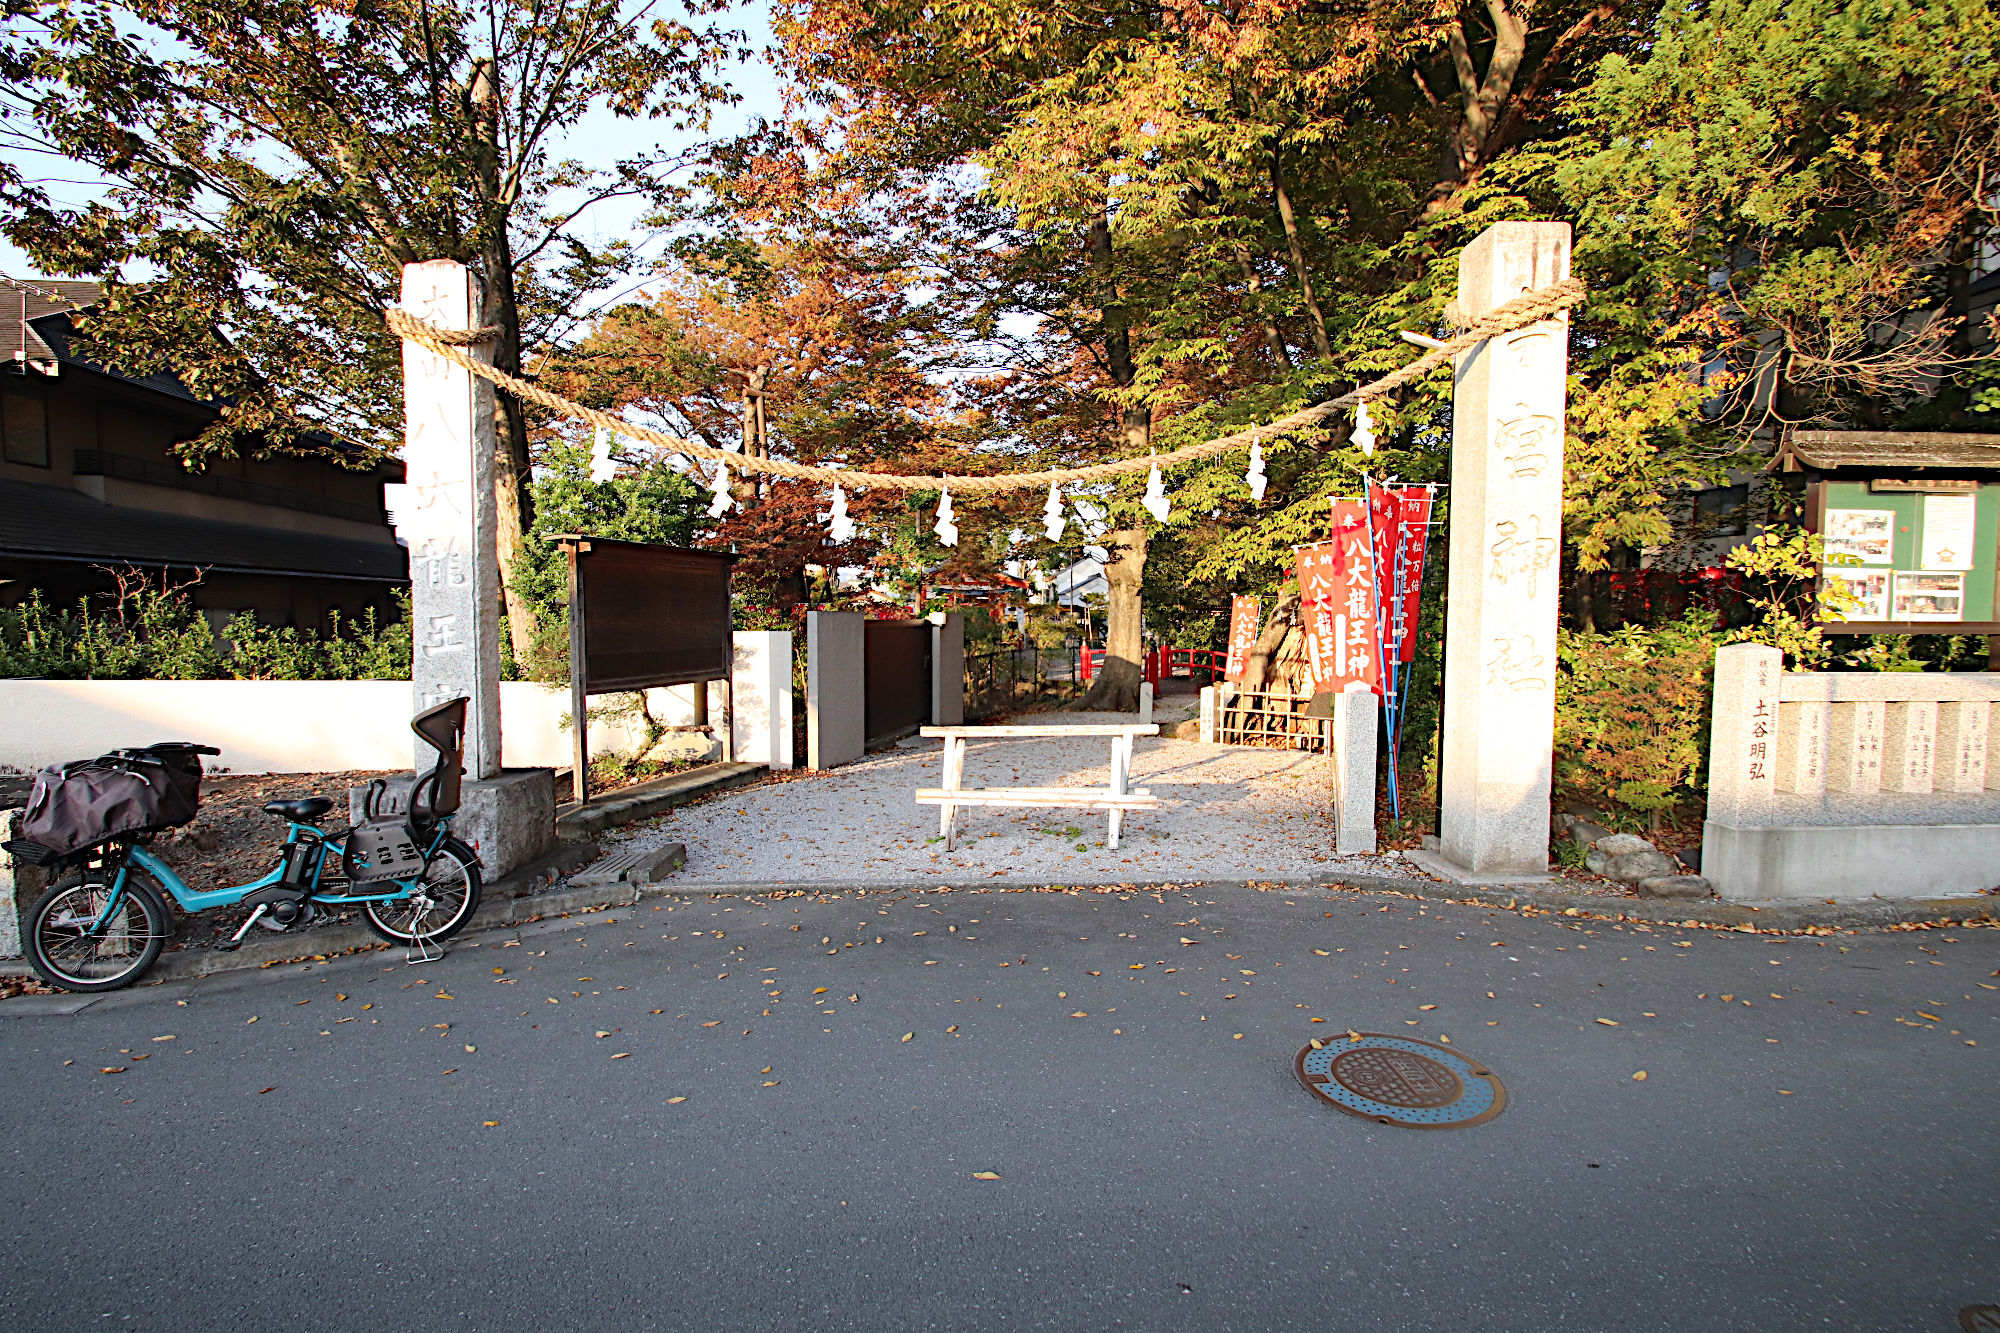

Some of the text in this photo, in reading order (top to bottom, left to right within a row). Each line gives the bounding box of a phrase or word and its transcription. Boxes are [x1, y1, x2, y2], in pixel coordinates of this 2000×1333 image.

[1411, 527, 1422, 592] 一粒万倍
[1232, 612, 1249, 676] 八大龍王神
[1344, 537, 1373, 678] 八大龍王神
[1749, 698, 1769, 781] 土谷明弘
